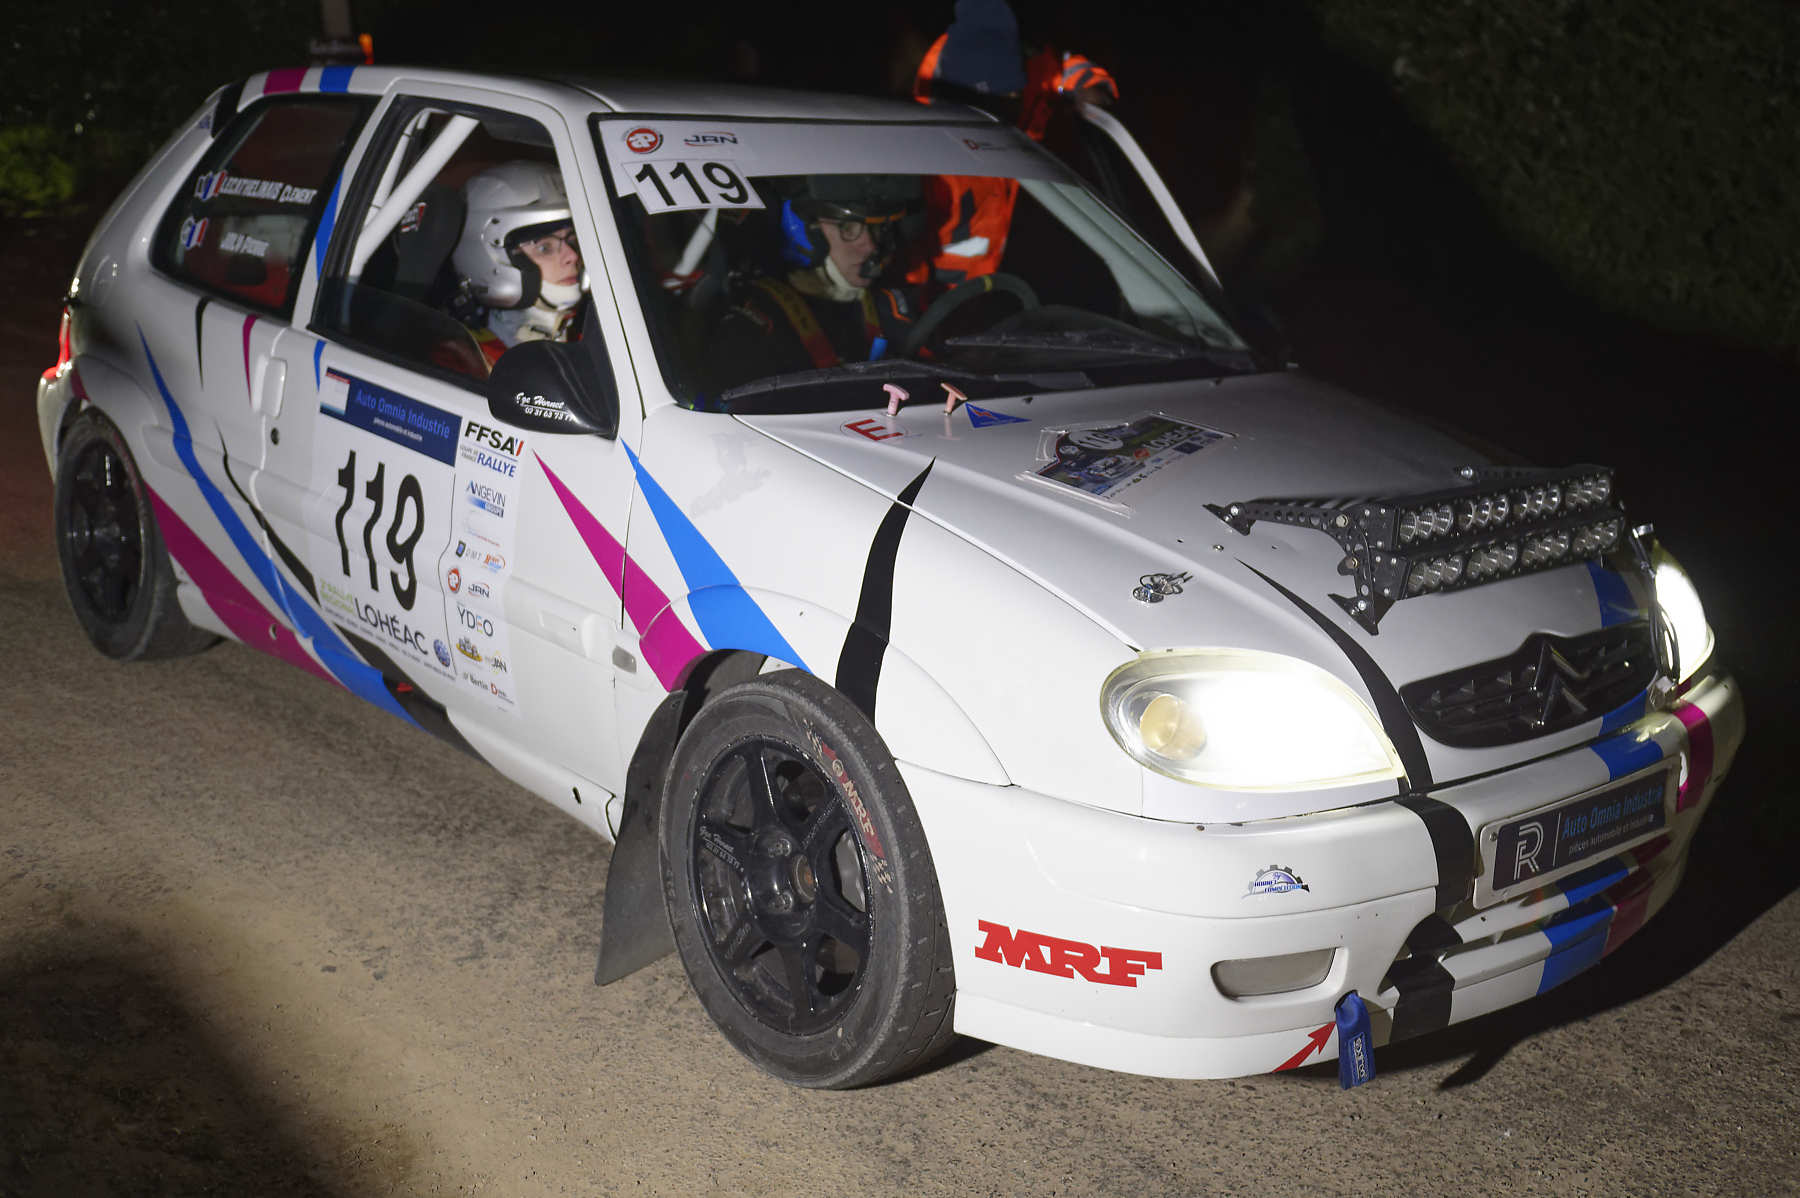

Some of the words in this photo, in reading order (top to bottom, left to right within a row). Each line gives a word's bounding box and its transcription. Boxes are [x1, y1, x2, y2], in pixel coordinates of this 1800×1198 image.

[635, 161, 749, 207] 119
[355, 388, 377, 409] Auto
[377, 397, 407, 421] Omnia
[407, 408, 451, 439] Industrie
[844, 408, 904, 441] E
[465, 421, 515, 456] FFSA
[476, 453, 517, 478] RALLYE
[466, 480, 506, 507] ANGEVIN
[335, 450, 425, 611] 119
[355, 598, 428, 655] LOHÉAC
[457, 606, 493, 637] YDEO
[1561, 816, 1588, 840] Auto
[1589, 802, 1623, 830] Omnia
[1622, 784, 1664, 815] Industrie
[974, 919, 1163, 988] MRF
